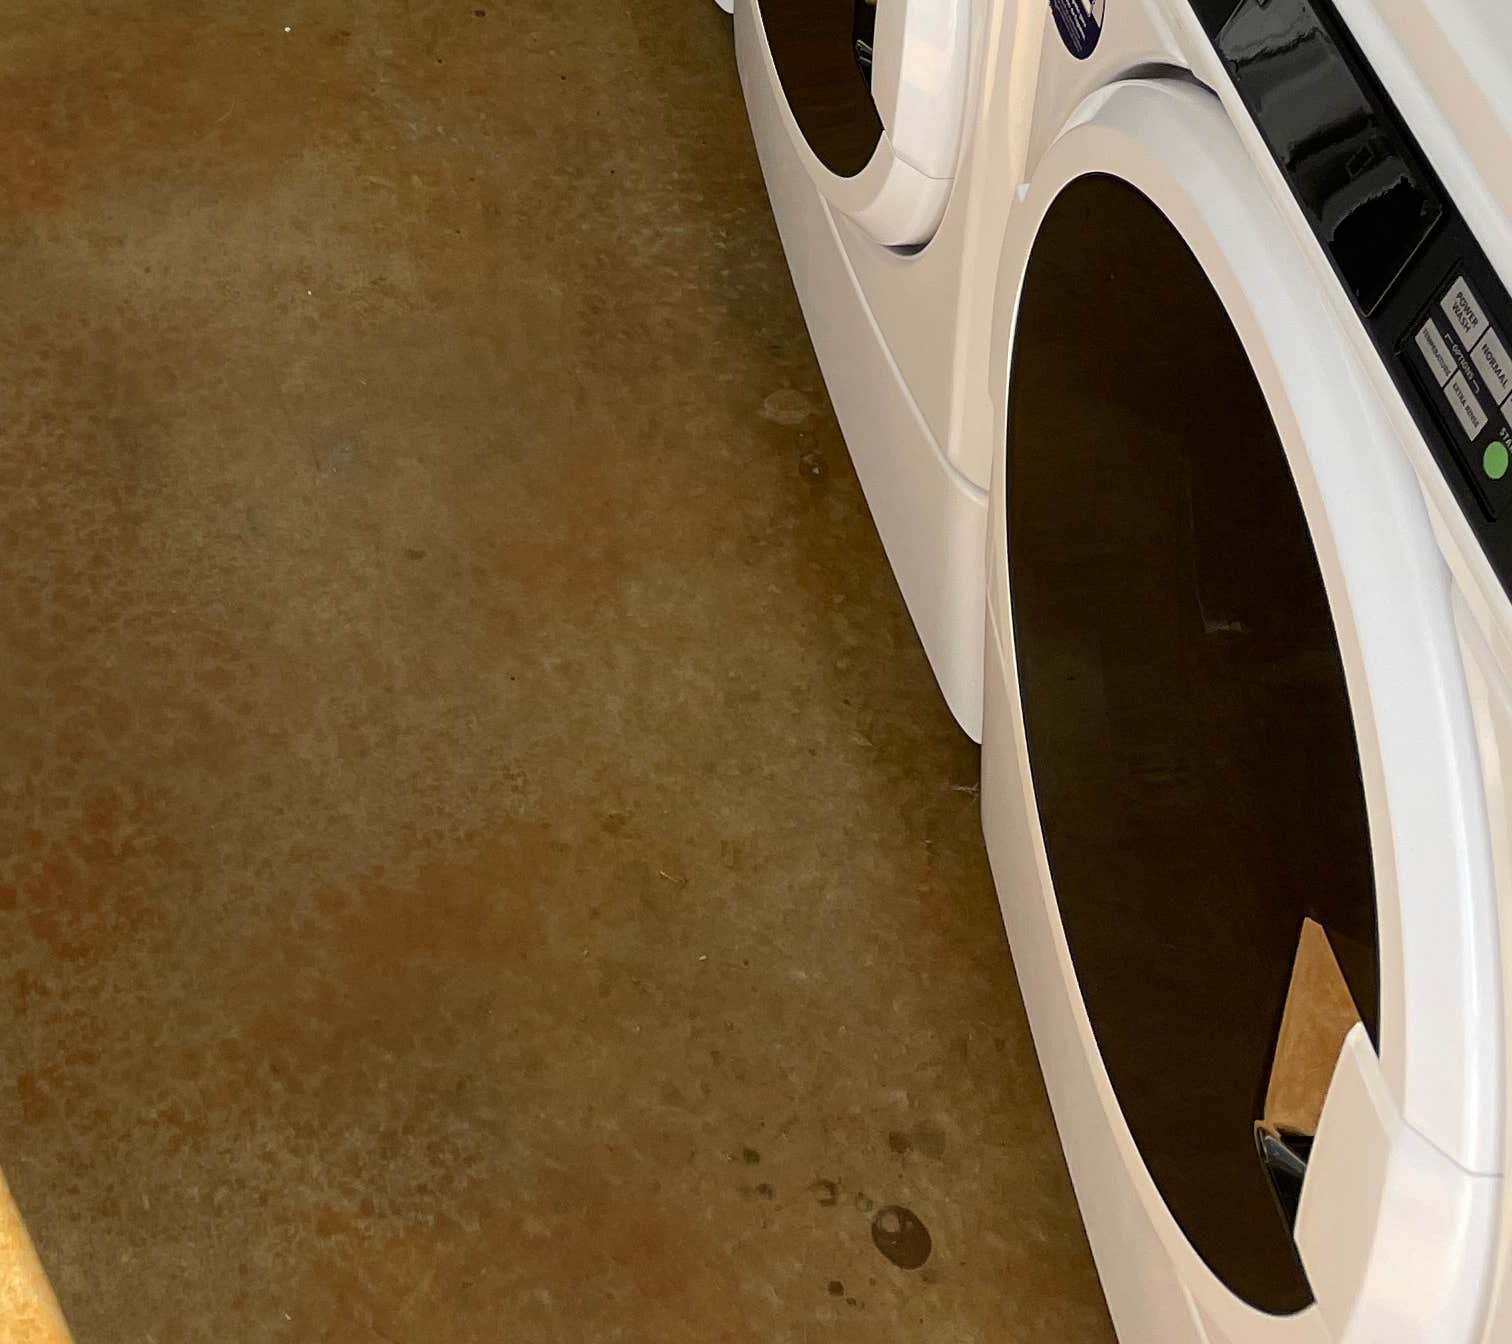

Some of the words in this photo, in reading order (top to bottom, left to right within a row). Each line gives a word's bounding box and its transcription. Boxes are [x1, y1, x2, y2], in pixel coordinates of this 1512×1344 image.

[1452, 303, 1472, 333] WASH
[1456, 292, 1480, 327] POWER
[1482, 343, 1509, 389] NORMAL
